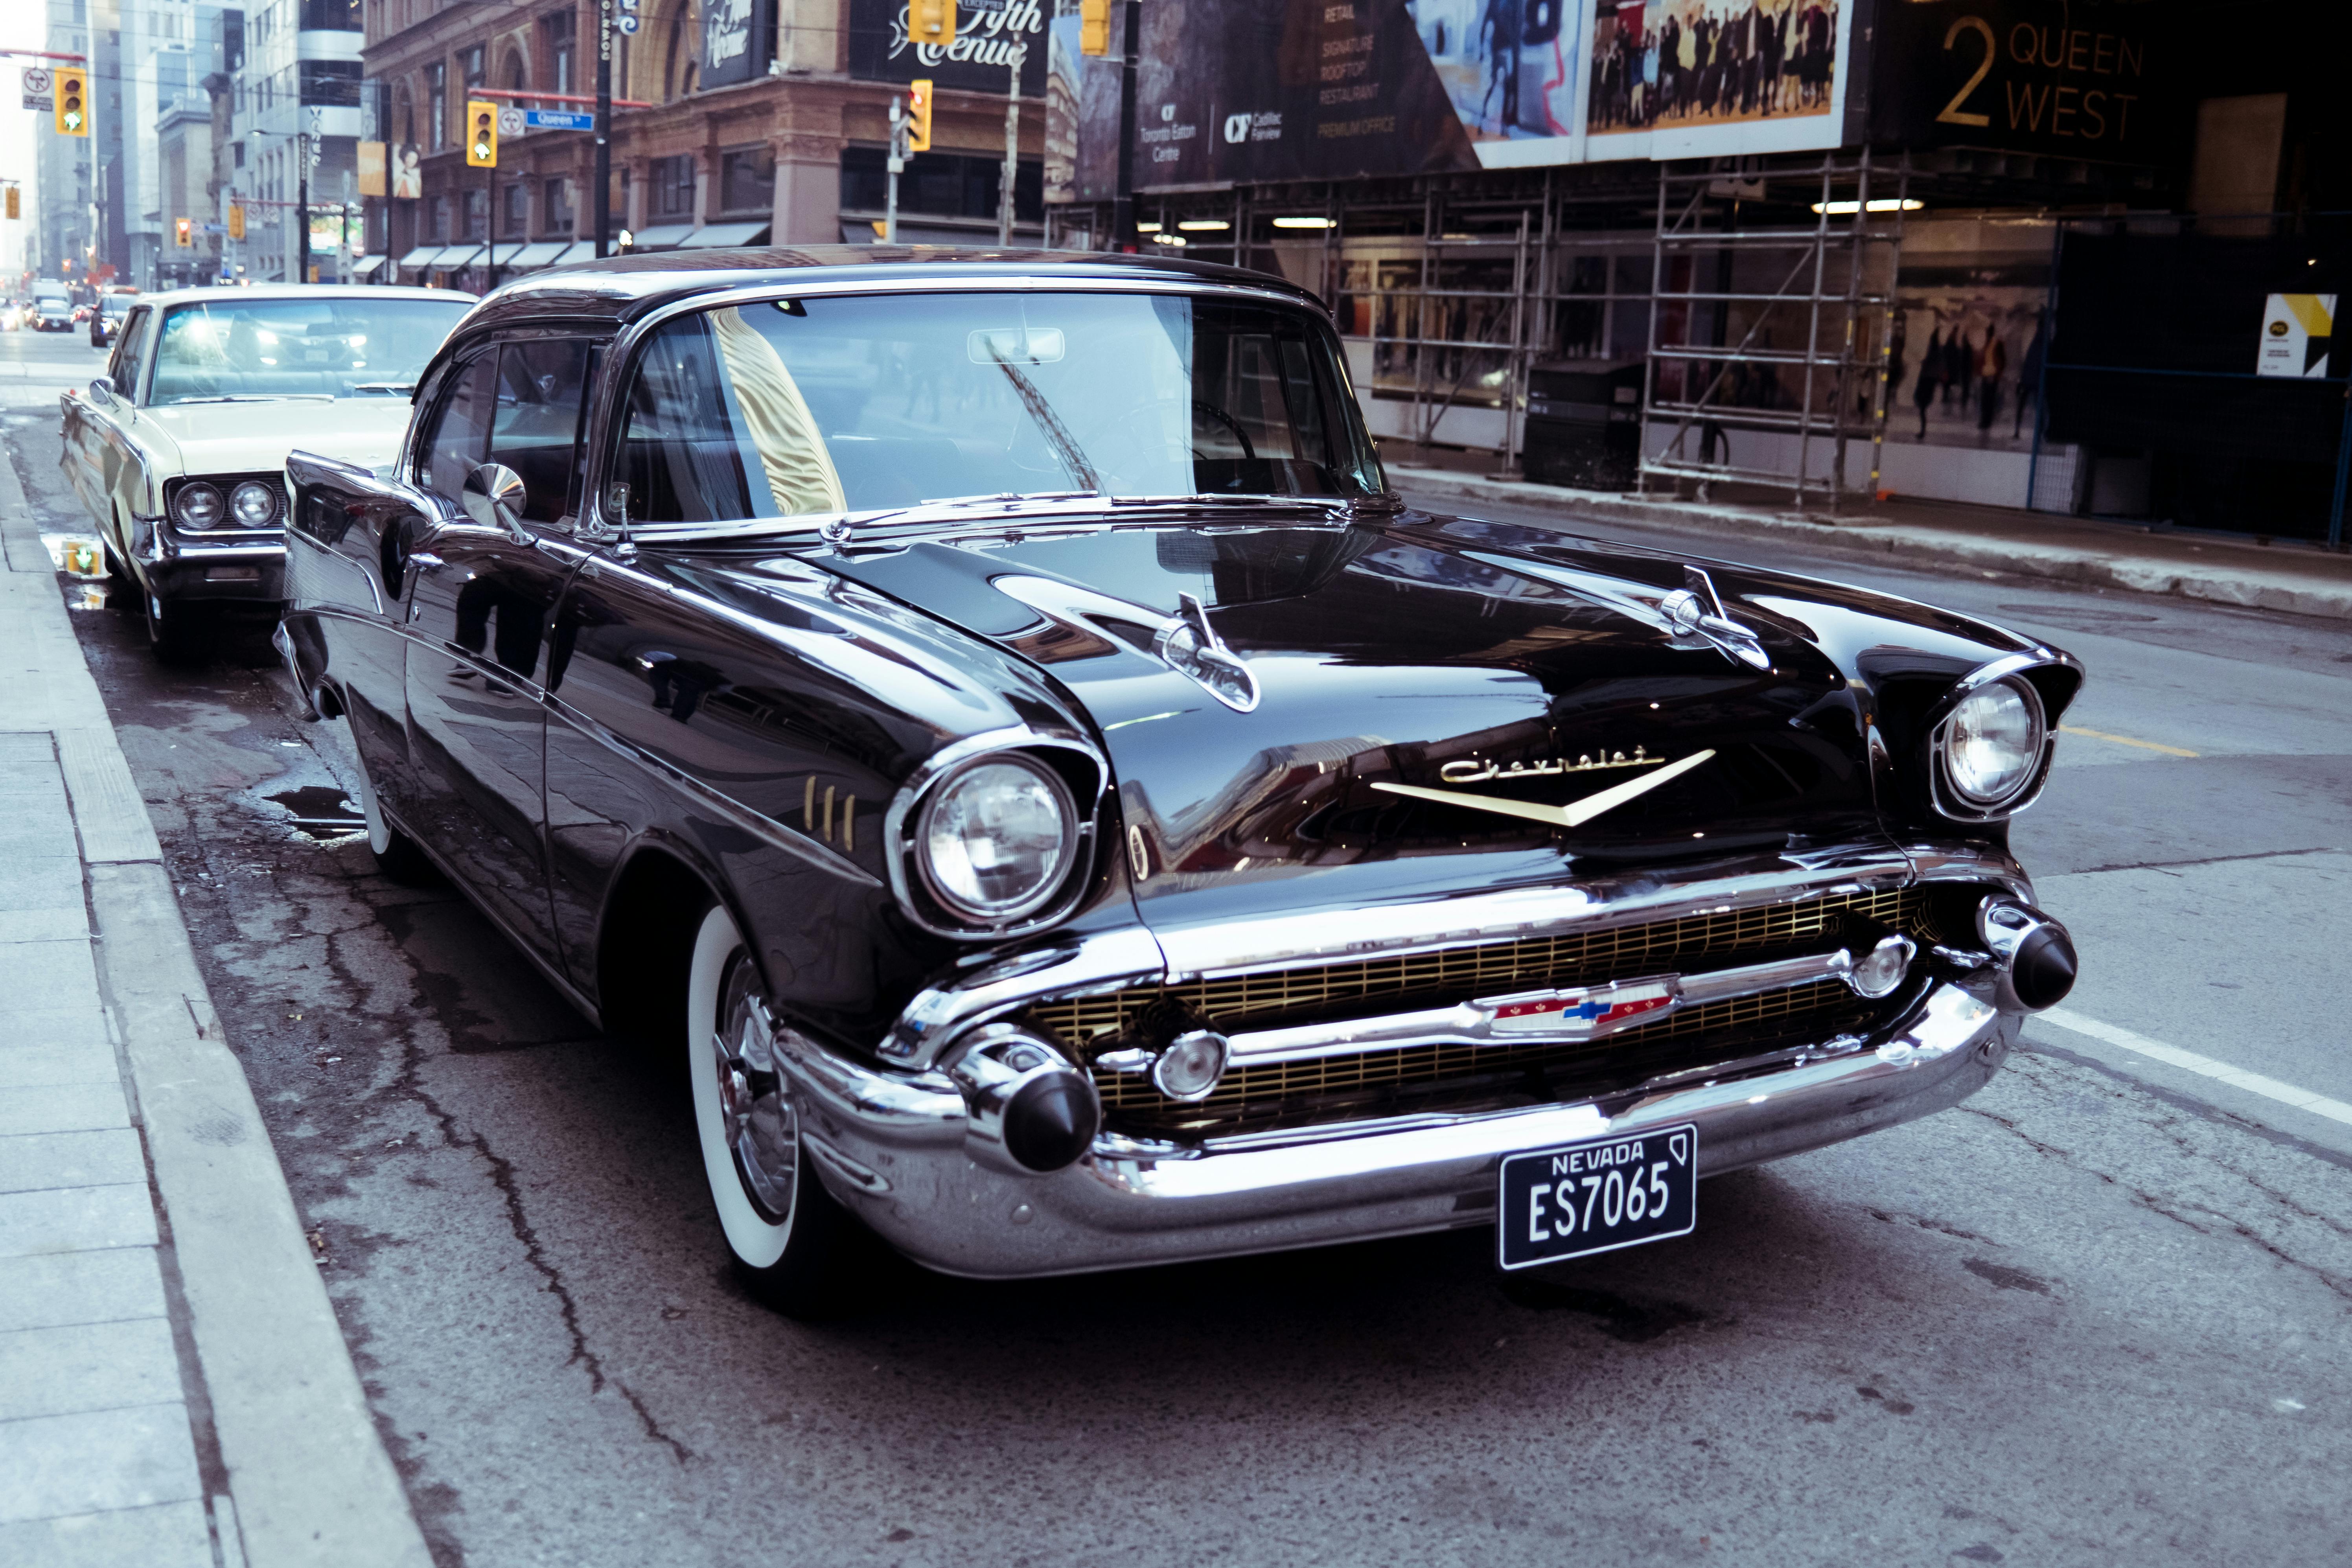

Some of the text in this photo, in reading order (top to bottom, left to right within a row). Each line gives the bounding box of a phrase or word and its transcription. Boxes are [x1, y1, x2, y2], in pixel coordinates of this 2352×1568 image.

[1324, 4, 1355, 23] RETAIL
[1322, 34, 1374, 57] SIGNATURE
[2009, 22, 2143, 77] QUEEN
[1321, 61, 1367, 81] ROOFTOP
[1935, 15, 1995, 127] 2
[1320, 83, 1379, 105] RESTAURANT
[537, 111, 573, 126] Queen
[2006, 80, 2138, 142] WEST
[1141, 123, 1196, 143] Toronto Eaton
[1224, 113, 1252, 143] CF
[1152, 147, 1180, 163] Centre
[1441, 745, 1665, 782] Chevrolet
[1552, 1141, 1644, 1176] NEVADA
[1529, 1161, 1669, 1242] ES7065
